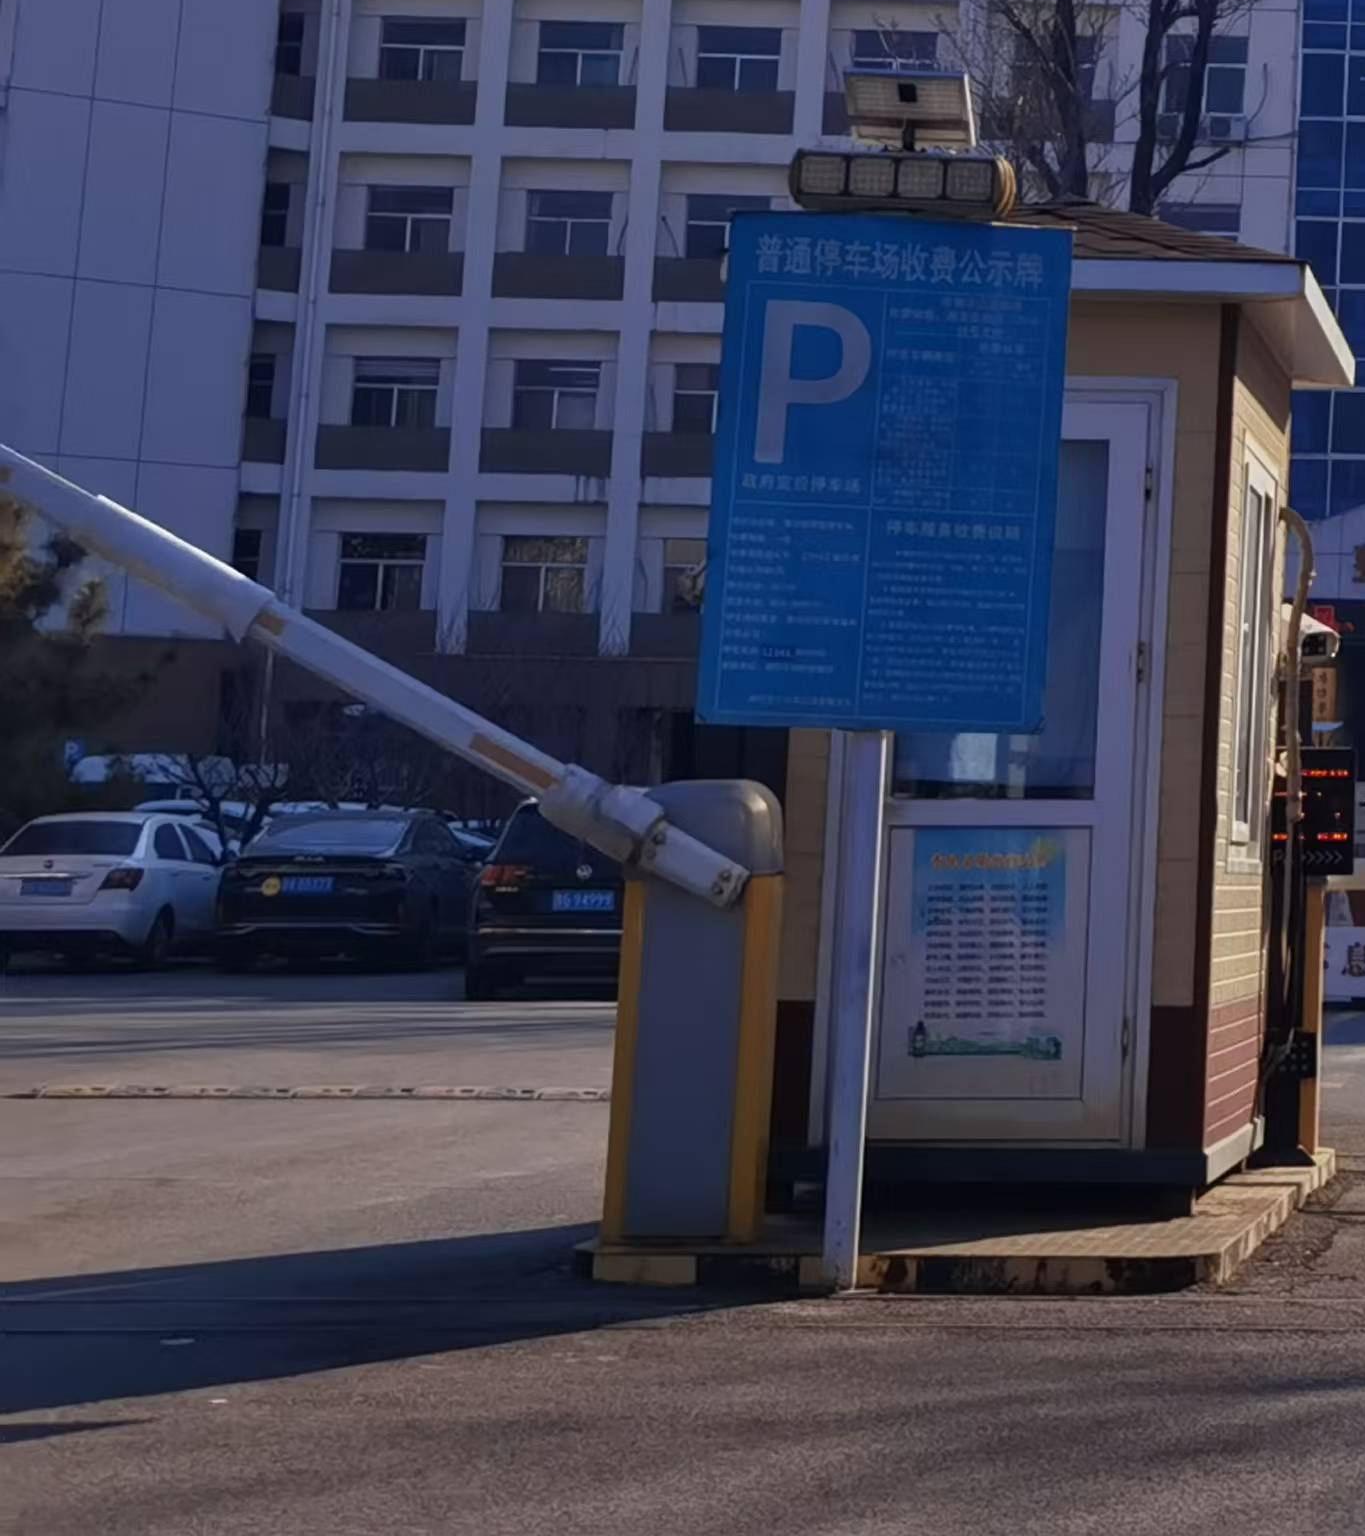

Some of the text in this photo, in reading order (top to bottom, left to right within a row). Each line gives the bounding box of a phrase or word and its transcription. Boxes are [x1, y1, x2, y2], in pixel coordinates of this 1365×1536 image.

[755, 233, 1044, 289] 普通停车场收费公示牌
[754, 299, 873, 465] P
